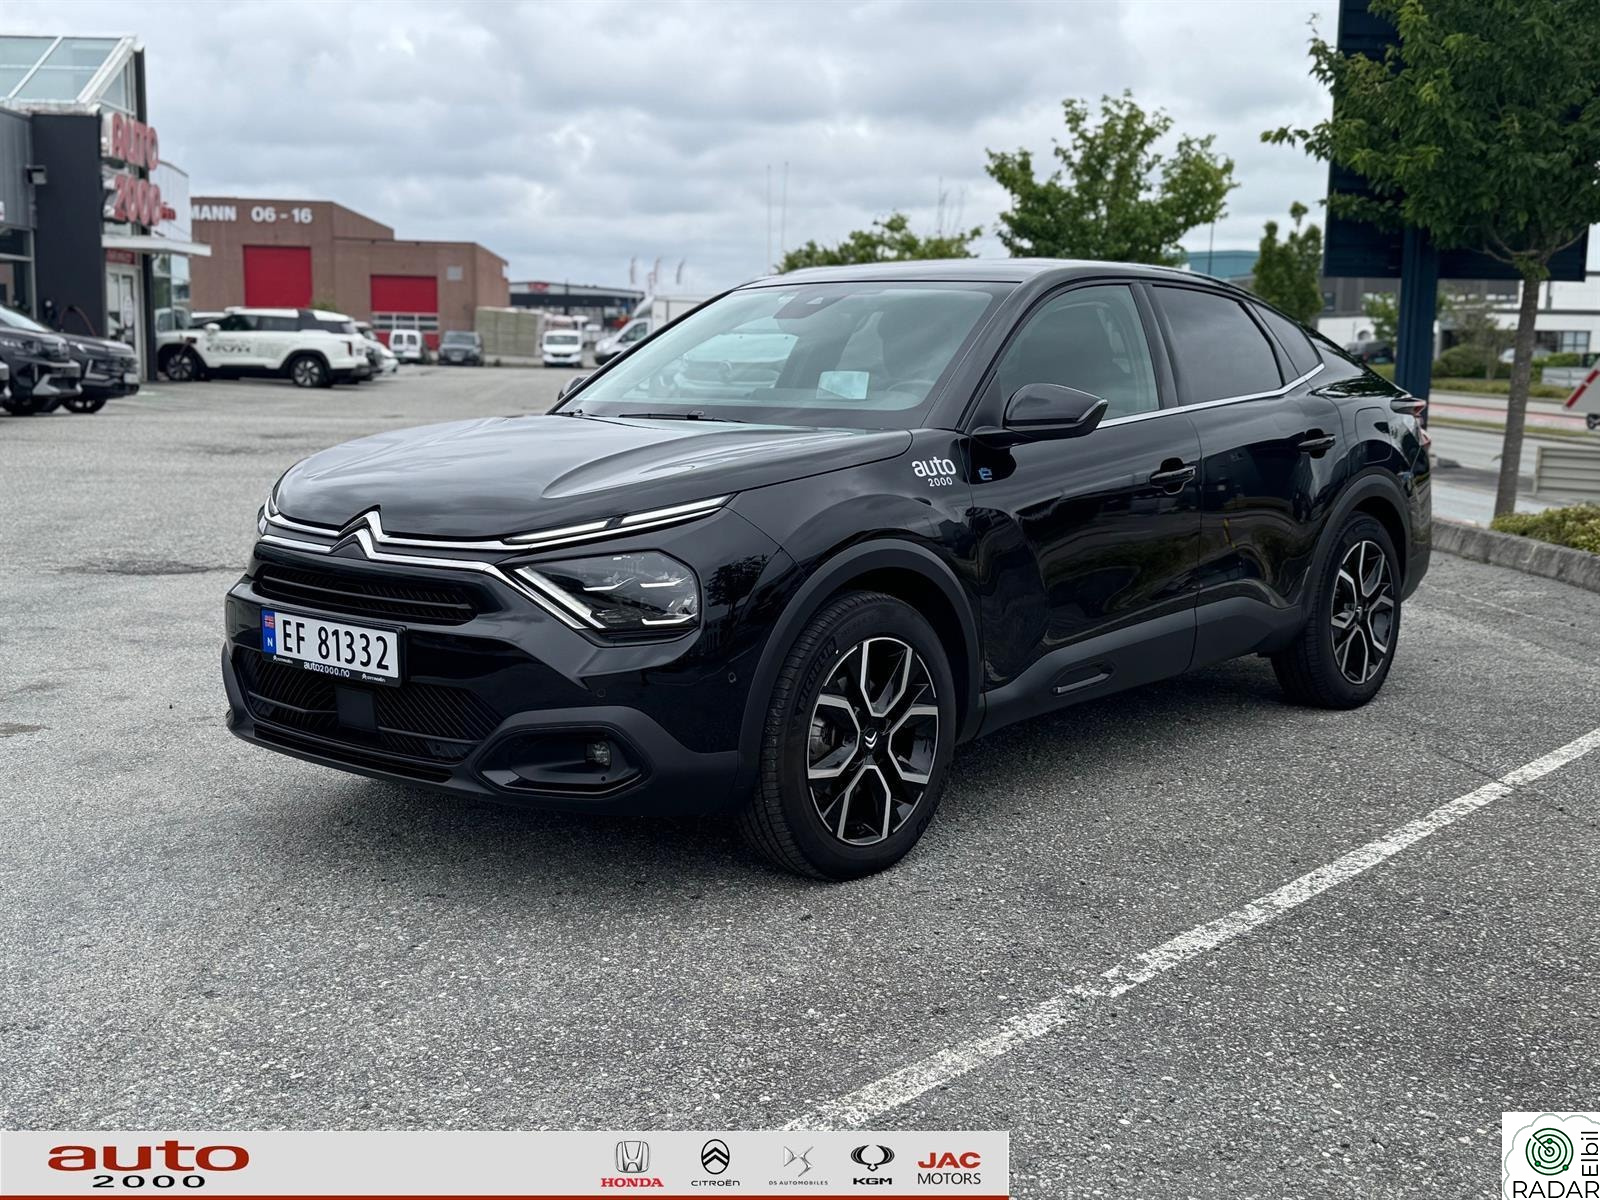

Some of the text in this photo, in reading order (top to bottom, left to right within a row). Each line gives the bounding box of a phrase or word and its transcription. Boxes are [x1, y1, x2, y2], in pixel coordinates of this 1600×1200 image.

[111, 112, 159, 170] AUTO
[114, 174, 161, 226] 2000
[251, 206, 276, 222] 06
[291, 208, 313, 223] 16
[911, 456, 957, 477] auto
[927, 476, 953, 487] 2000
[266, 637, 274, 647] N
[282, 619, 390, 671] EF 81332
[303, 660, 350, 678] auto2000.no
